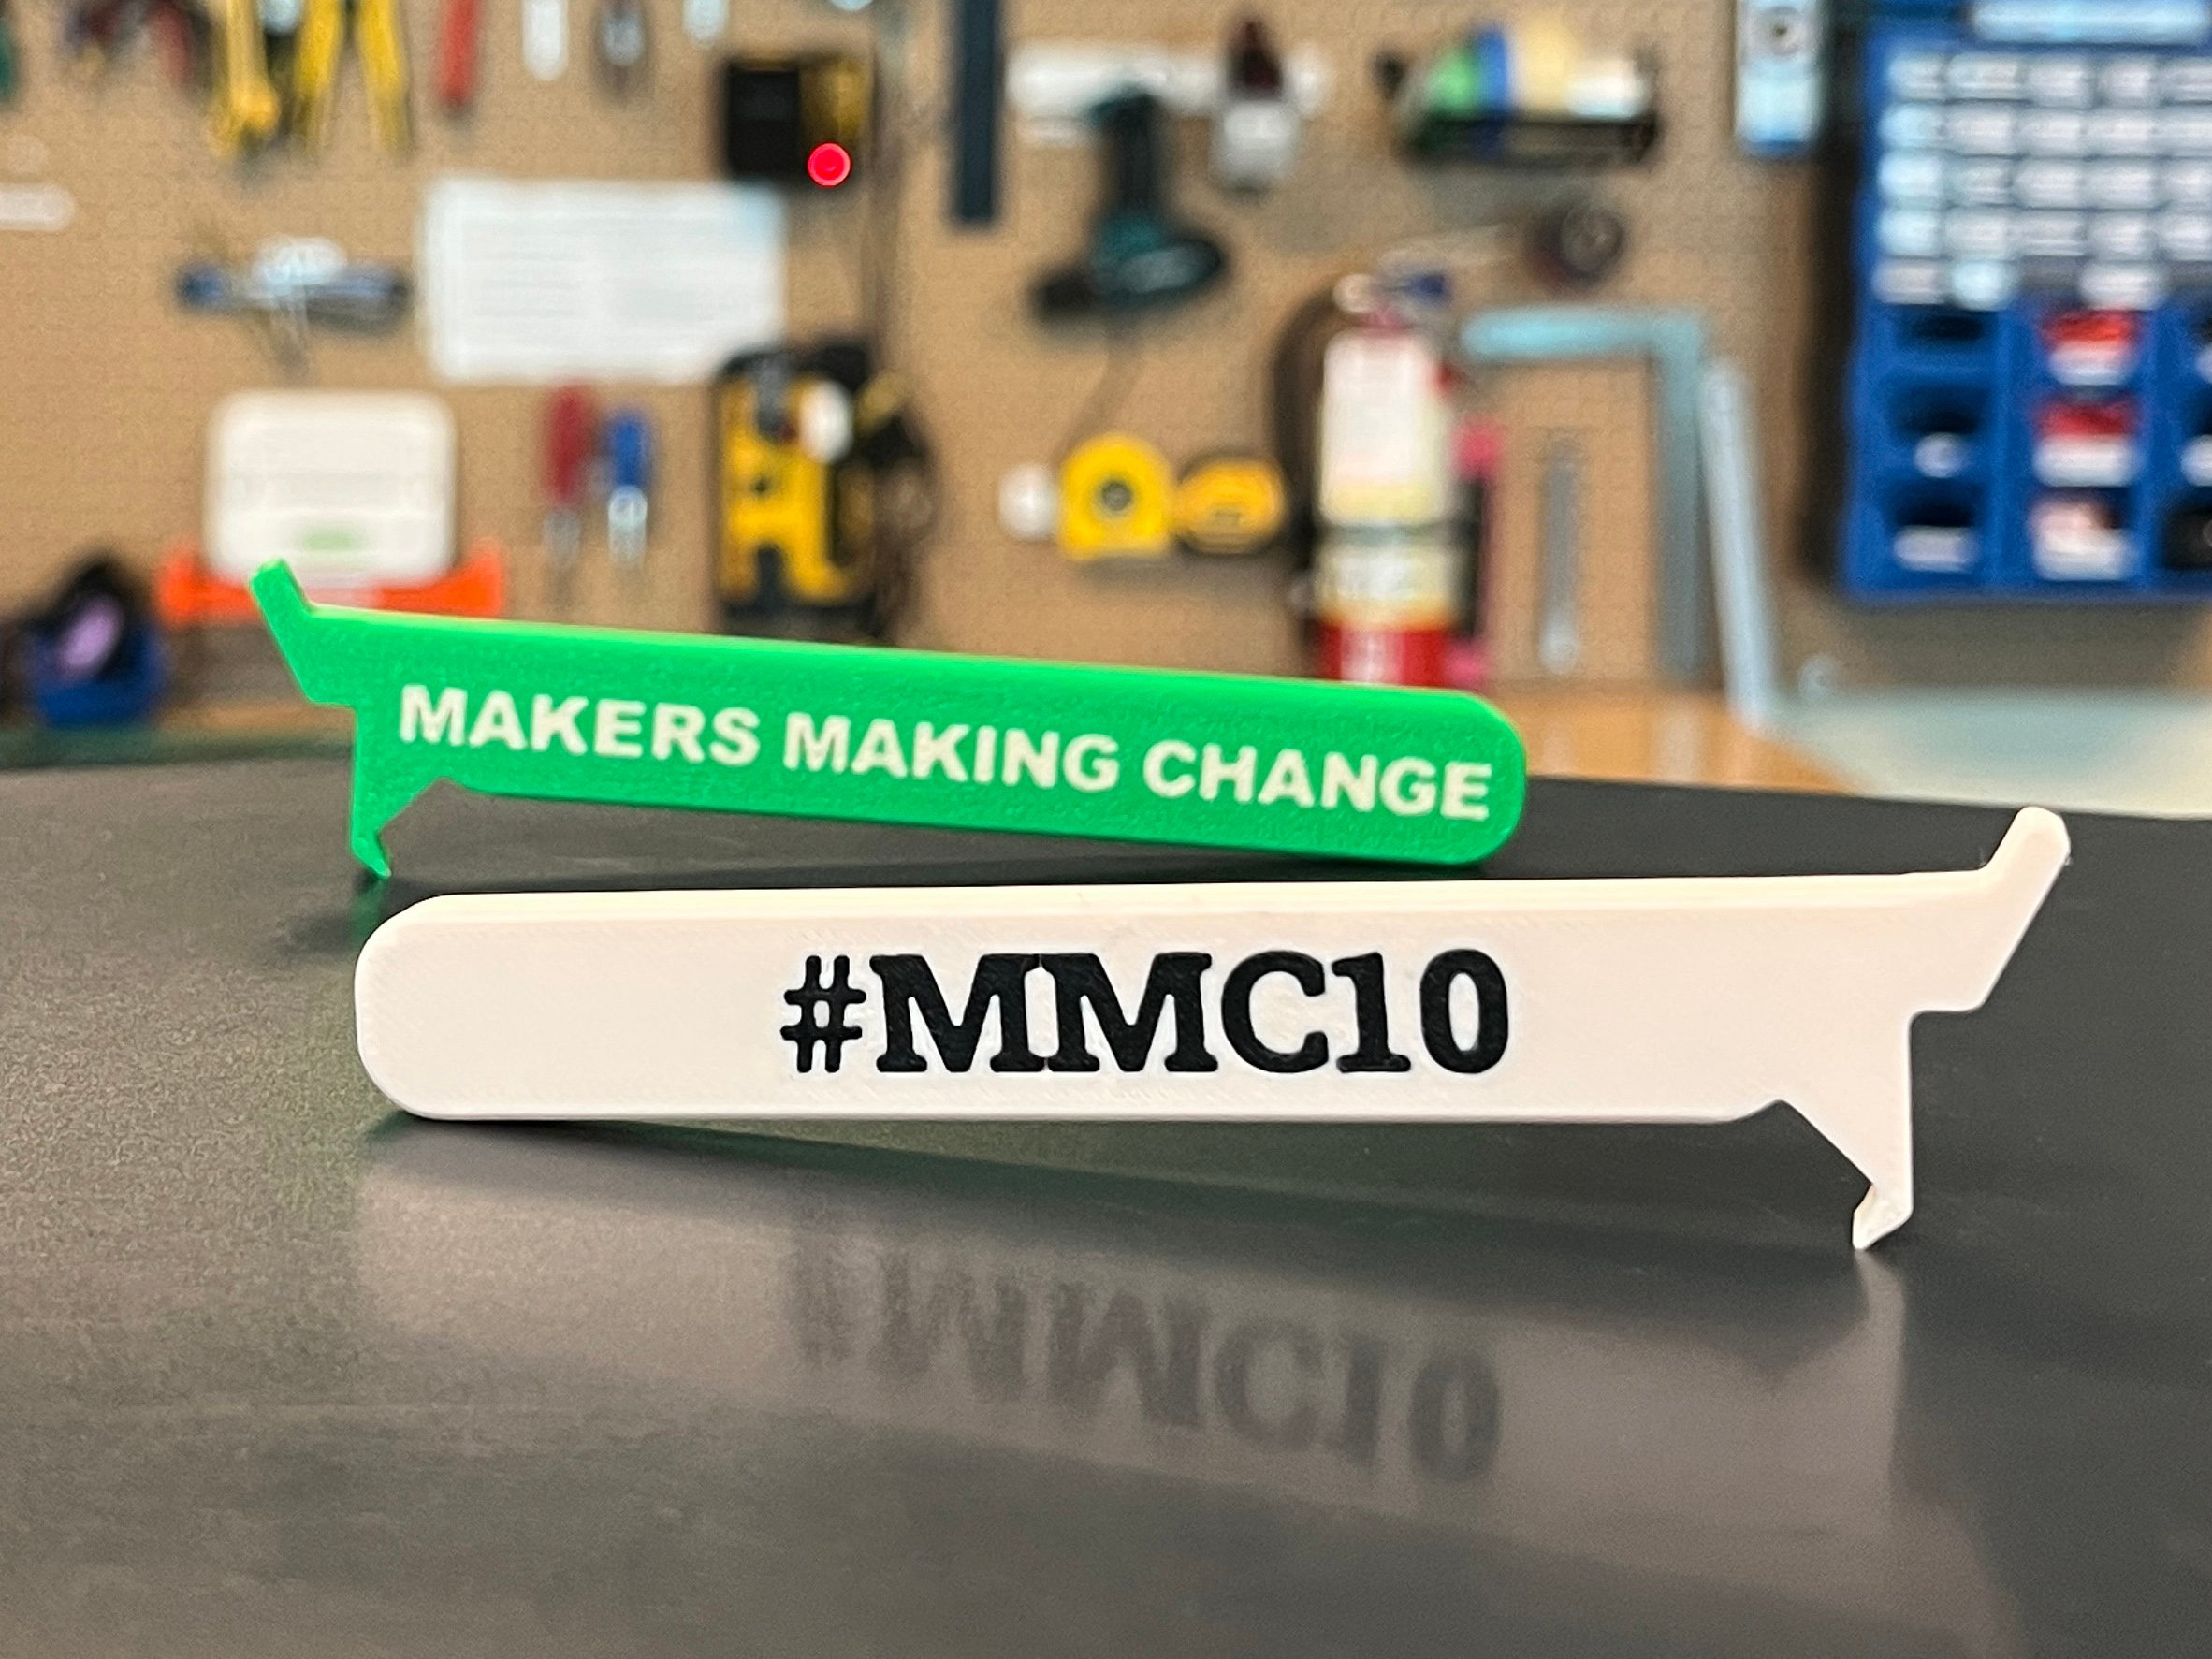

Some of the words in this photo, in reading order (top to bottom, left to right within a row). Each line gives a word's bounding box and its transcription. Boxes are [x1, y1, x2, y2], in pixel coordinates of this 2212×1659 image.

[400, 685, 761, 766] MAKERS
[783, 712, 1119, 793] MAKING
[1143, 740, 1492, 821] CHANGE
[779, 949, 1510, 1075] #MMC10
